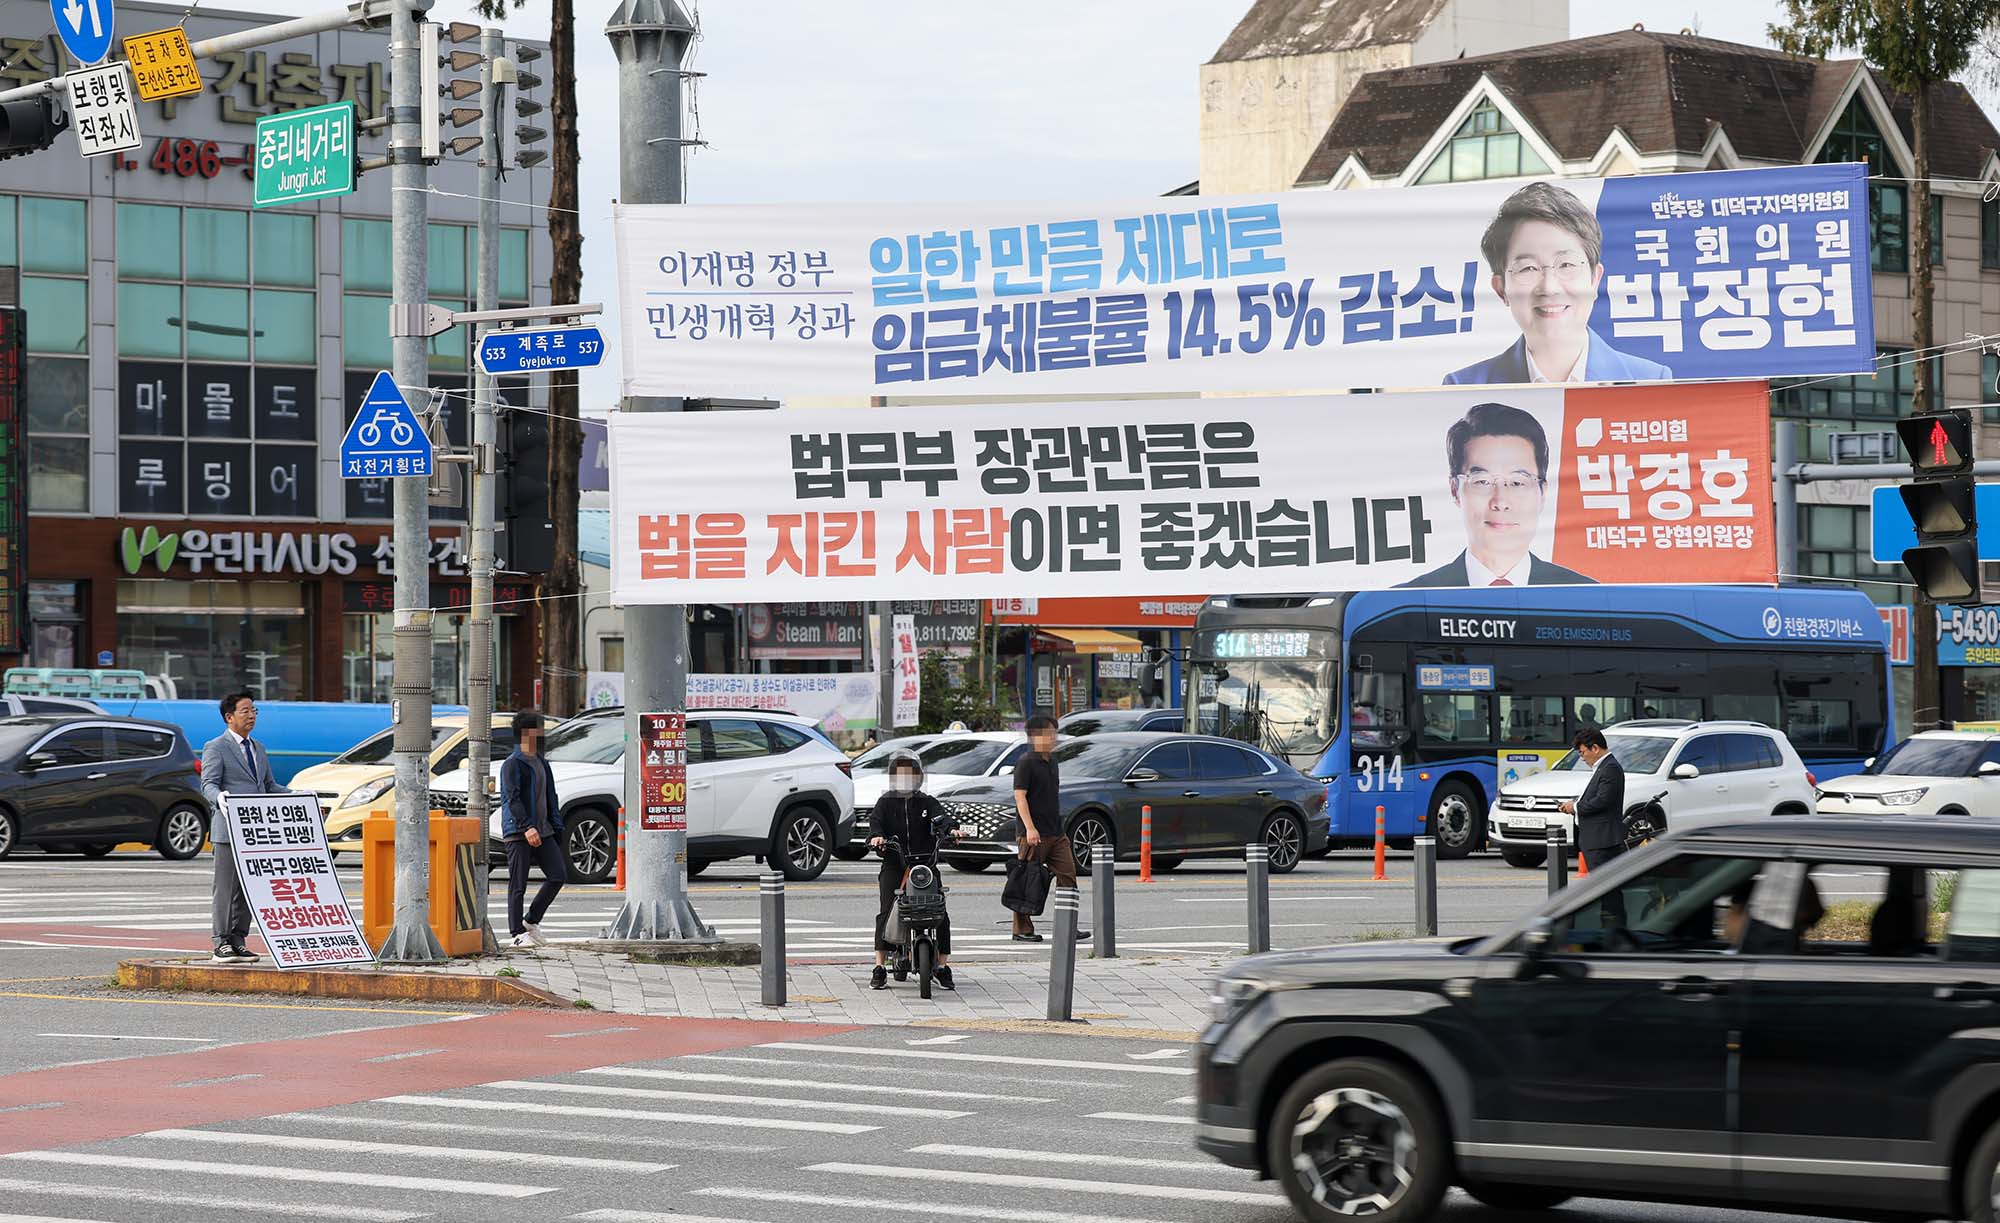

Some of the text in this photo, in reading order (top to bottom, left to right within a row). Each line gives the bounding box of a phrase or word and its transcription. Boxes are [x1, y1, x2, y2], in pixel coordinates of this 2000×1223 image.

[129, 36, 187, 66] 긴급차량
[72, 71, 128, 109] 보행및
[137, 64, 198, 94] 우선신호구간
[79, 109, 136, 147] 직좌시
[259, 115, 347, 169] 중리네거리
[277, 166, 327, 193] Jungri Jct
[1651, 190, 1849, 220] 민주당 대덕구지역위원회
[870, 203, 1287, 306] 일한 만큼 제대로
[1635, 219, 1850, 267] 국회의원
[659, 250, 834, 287] 이재명 정부
[1607, 263, 1856, 353] 박정현
[646, 302, 856, 341] 민생개혁 성과
[872, 261, 1478, 385] 임금체불률 14.5% 감소!
[486, 347, 506, 361] 533
[519, 334, 566, 351] 계족로
[579, 341, 599, 354] 537
[519, 355, 566, 369] Gyejok-ro
[1609, 419, 1688, 443] 국민의힘
[348, 458, 426, 476] 자전거횡단
[790, 421, 1260, 500] 법무부 장관만큼은
[1576, 450, 1753, 520] 박경호
[638, 498, 1432, 581] 법을 지킨 사람이면 좋겠습니다
[1586, 525, 1754, 549] 대덕구 당협위원장
[776, 621, 855, 642] Steam Man
[1440, 618, 1516, 639] ELEC CITY
[1535, 627, 1632, 641] ZERO EMISSION BUS
[1784, 617, 1864, 638] 친환경전기버스
[1216, 633, 1246, 657] 314
[652, 719, 666, 729] 10
[1357, 754, 1403, 792] 314
[661, 782, 685, 803] 90
[237, 805, 313, 825] 멈춰 선 의회,
[242, 827, 315, 846] 멍드는 민생!
[245, 857, 329, 877] 대덕구 의회는
[269, 878, 320, 905] 즉각
[259, 905, 351, 931] 정상화하라!
[275, 934, 360, 951] 구민 볼모 정치싸움
[280, 947, 367, 963] 즉각 중단하십시오!
